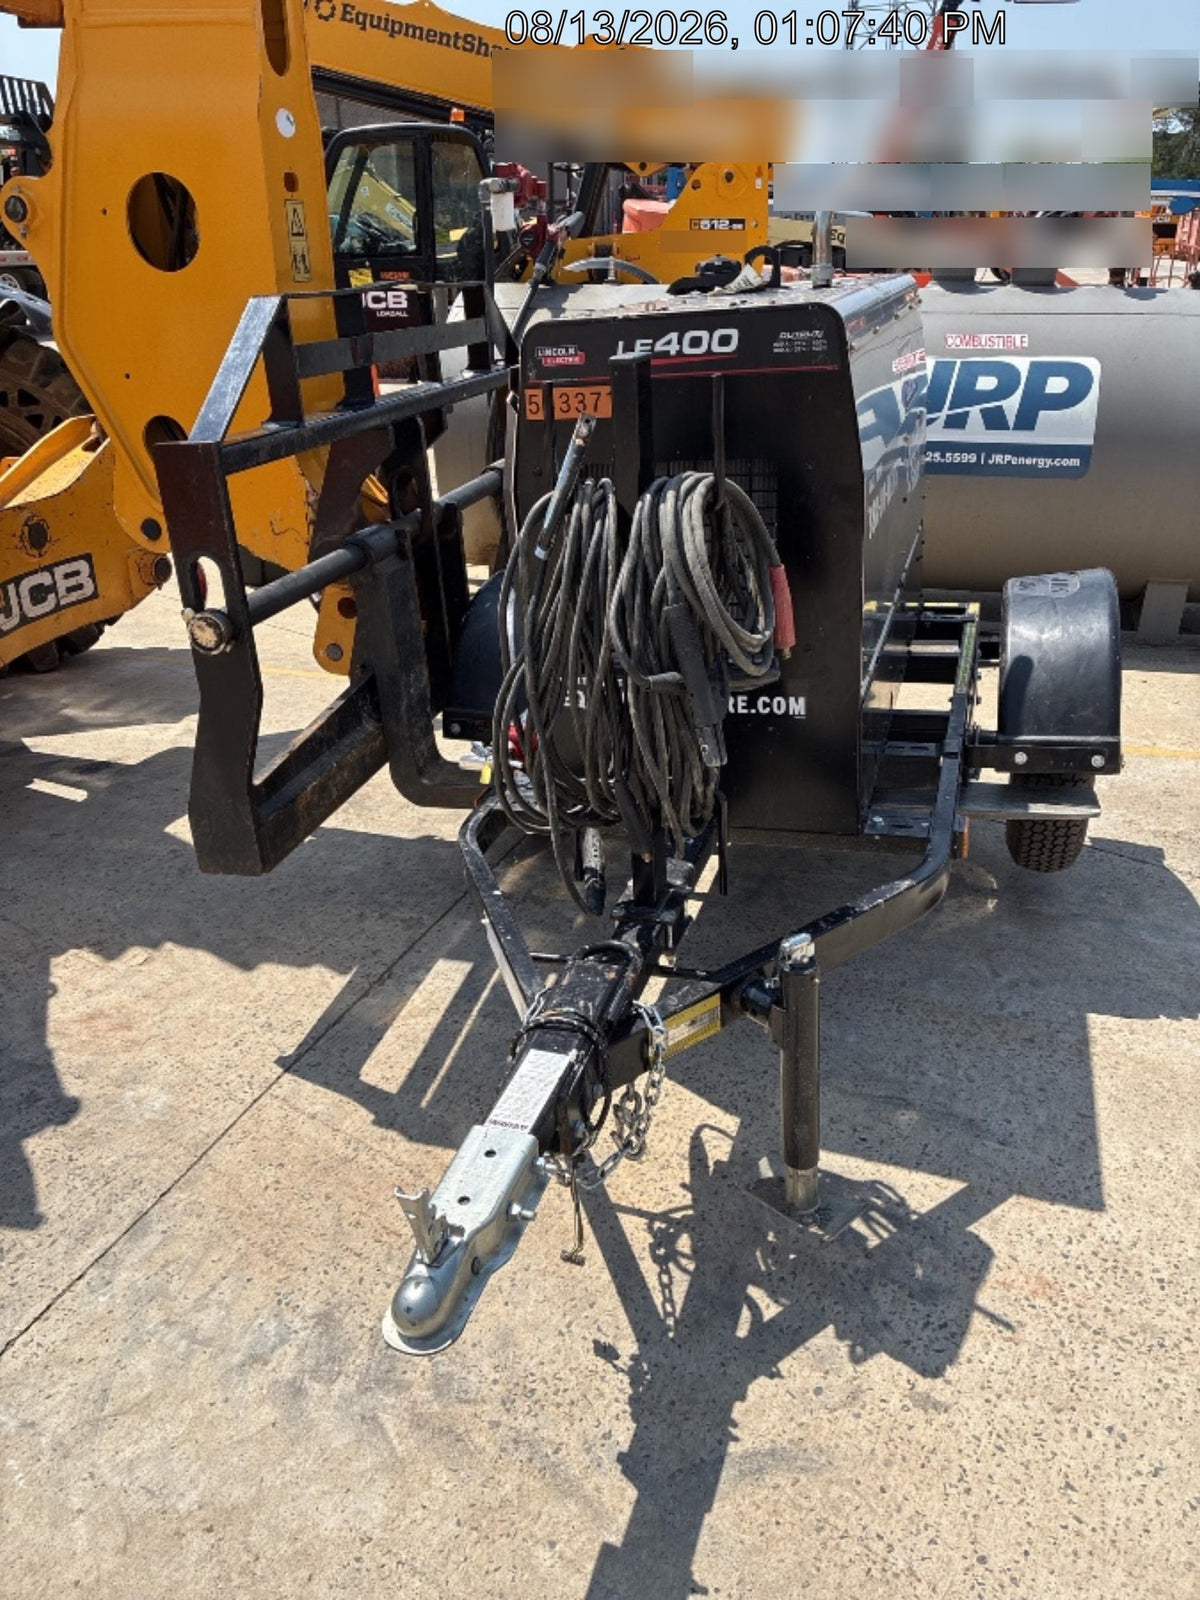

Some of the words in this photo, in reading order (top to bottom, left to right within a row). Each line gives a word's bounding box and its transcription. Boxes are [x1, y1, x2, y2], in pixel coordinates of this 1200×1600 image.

[615, 328, 739, 357] LE400
[945, 334, 1028, 349] COMBUSTIBLE
[537, 347, 576, 357] LINCOLN
[988, 452, 1080, 468] JRPenergy.com
[0, 560, 95, 632] JCB
